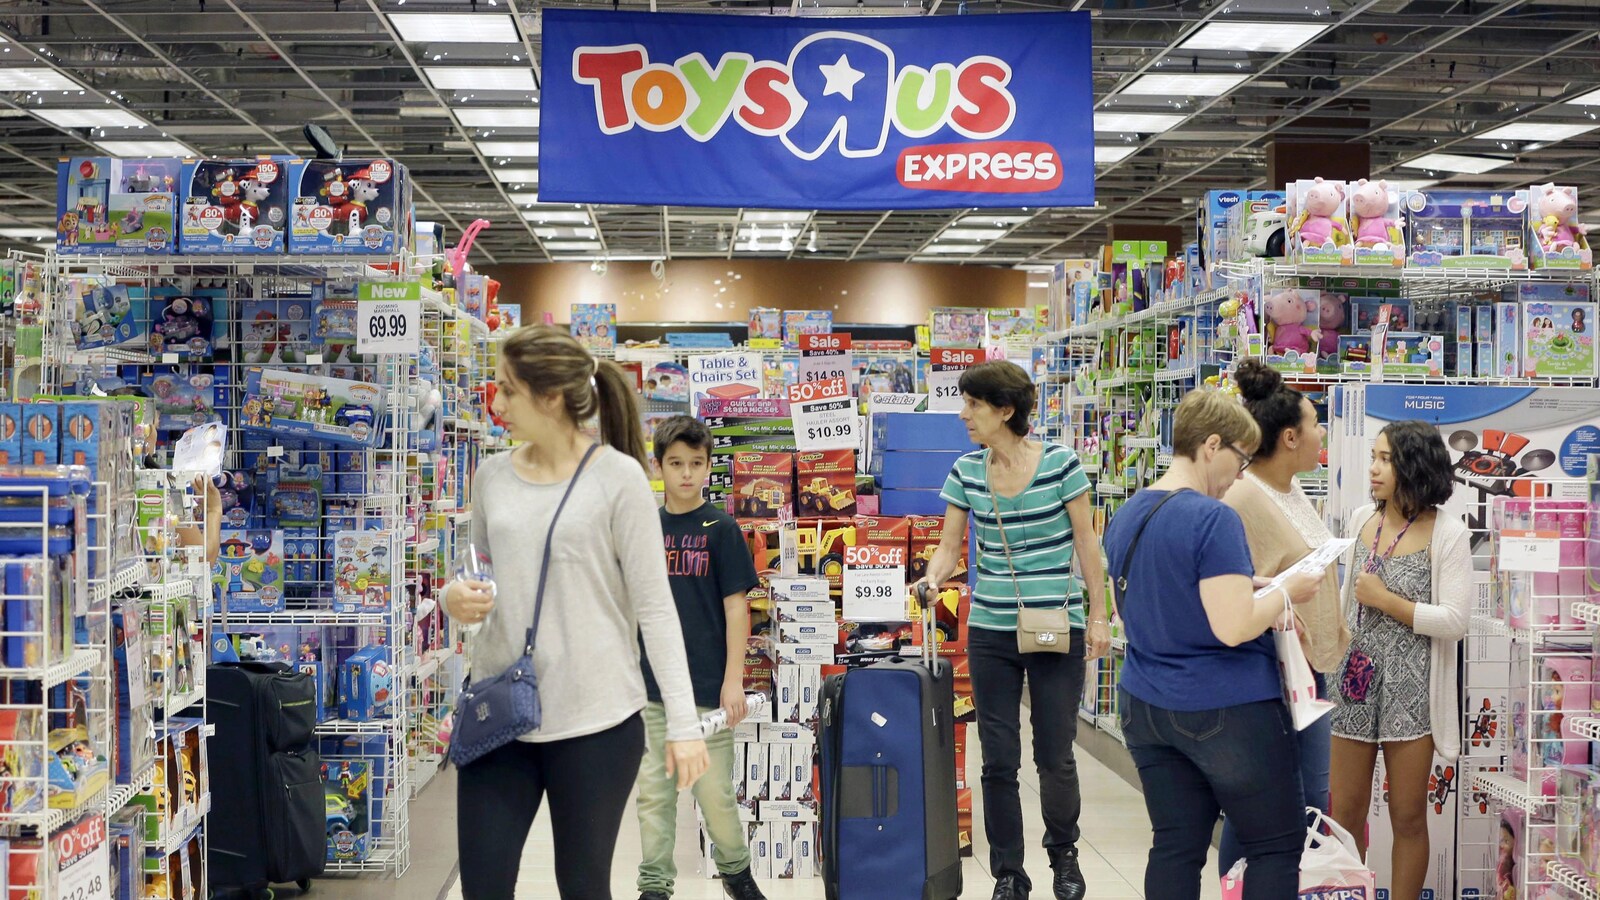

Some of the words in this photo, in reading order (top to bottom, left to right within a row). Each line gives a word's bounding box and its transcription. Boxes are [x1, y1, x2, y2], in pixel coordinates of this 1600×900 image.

[904, 152, 1056, 182] EXPRESS
[371, 284, 407, 299] New
[369, 314, 407, 338] 69.99
[809, 335, 840, 348] Sale
[699, 358, 735, 369] Table
[738, 357, 748, 367] &
[941, 350, 974, 363] Sale
[692, 371, 732, 383] Chairs
[736, 369, 757, 380] Set
[806, 370, 845, 381] $1499
[790, 381, 822, 402] 50%
[822, 379, 844, 396] off
[936, 386, 963, 398] $12.
[810, 404, 827, 412] Save
[829, 402, 844, 410] 50%
[1404, 400, 1445, 410] MUSIC
[808, 424, 851, 440] $10.99
[681, 534, 708, 548] CLUB
[846, 547, 879, 563] 50%
[879, 548, 902, 563] off
[666, 550, 710, 577] ELONA
[855, 586, 892, 599] $9.98
[81, 817, 102, 848] off
[62, 875, 102, 900] 12.48
